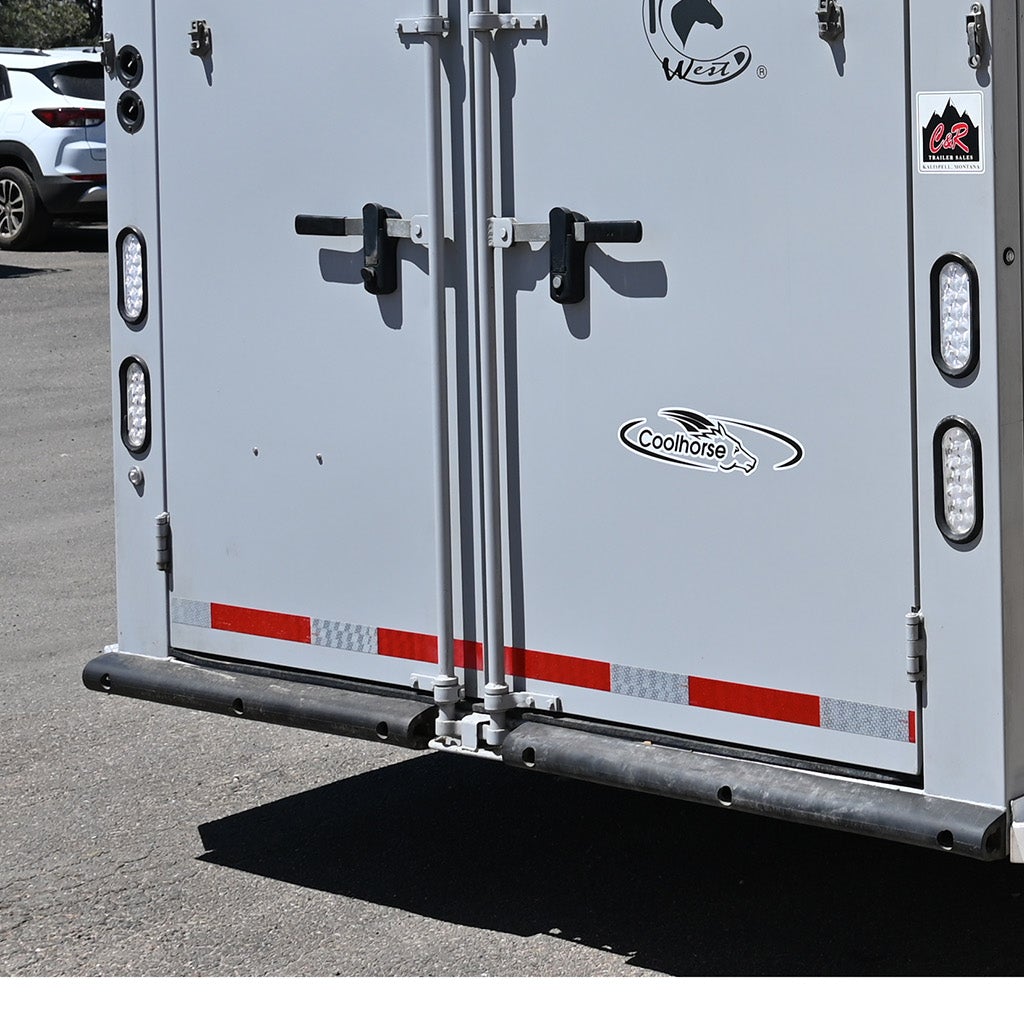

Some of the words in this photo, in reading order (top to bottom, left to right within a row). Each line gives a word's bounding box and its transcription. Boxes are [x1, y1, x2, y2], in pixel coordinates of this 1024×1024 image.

[662, 57, 730, 81] West
[929, 122, 969, 154] C&R
[638, 429, 727, 459] Coolhorse
